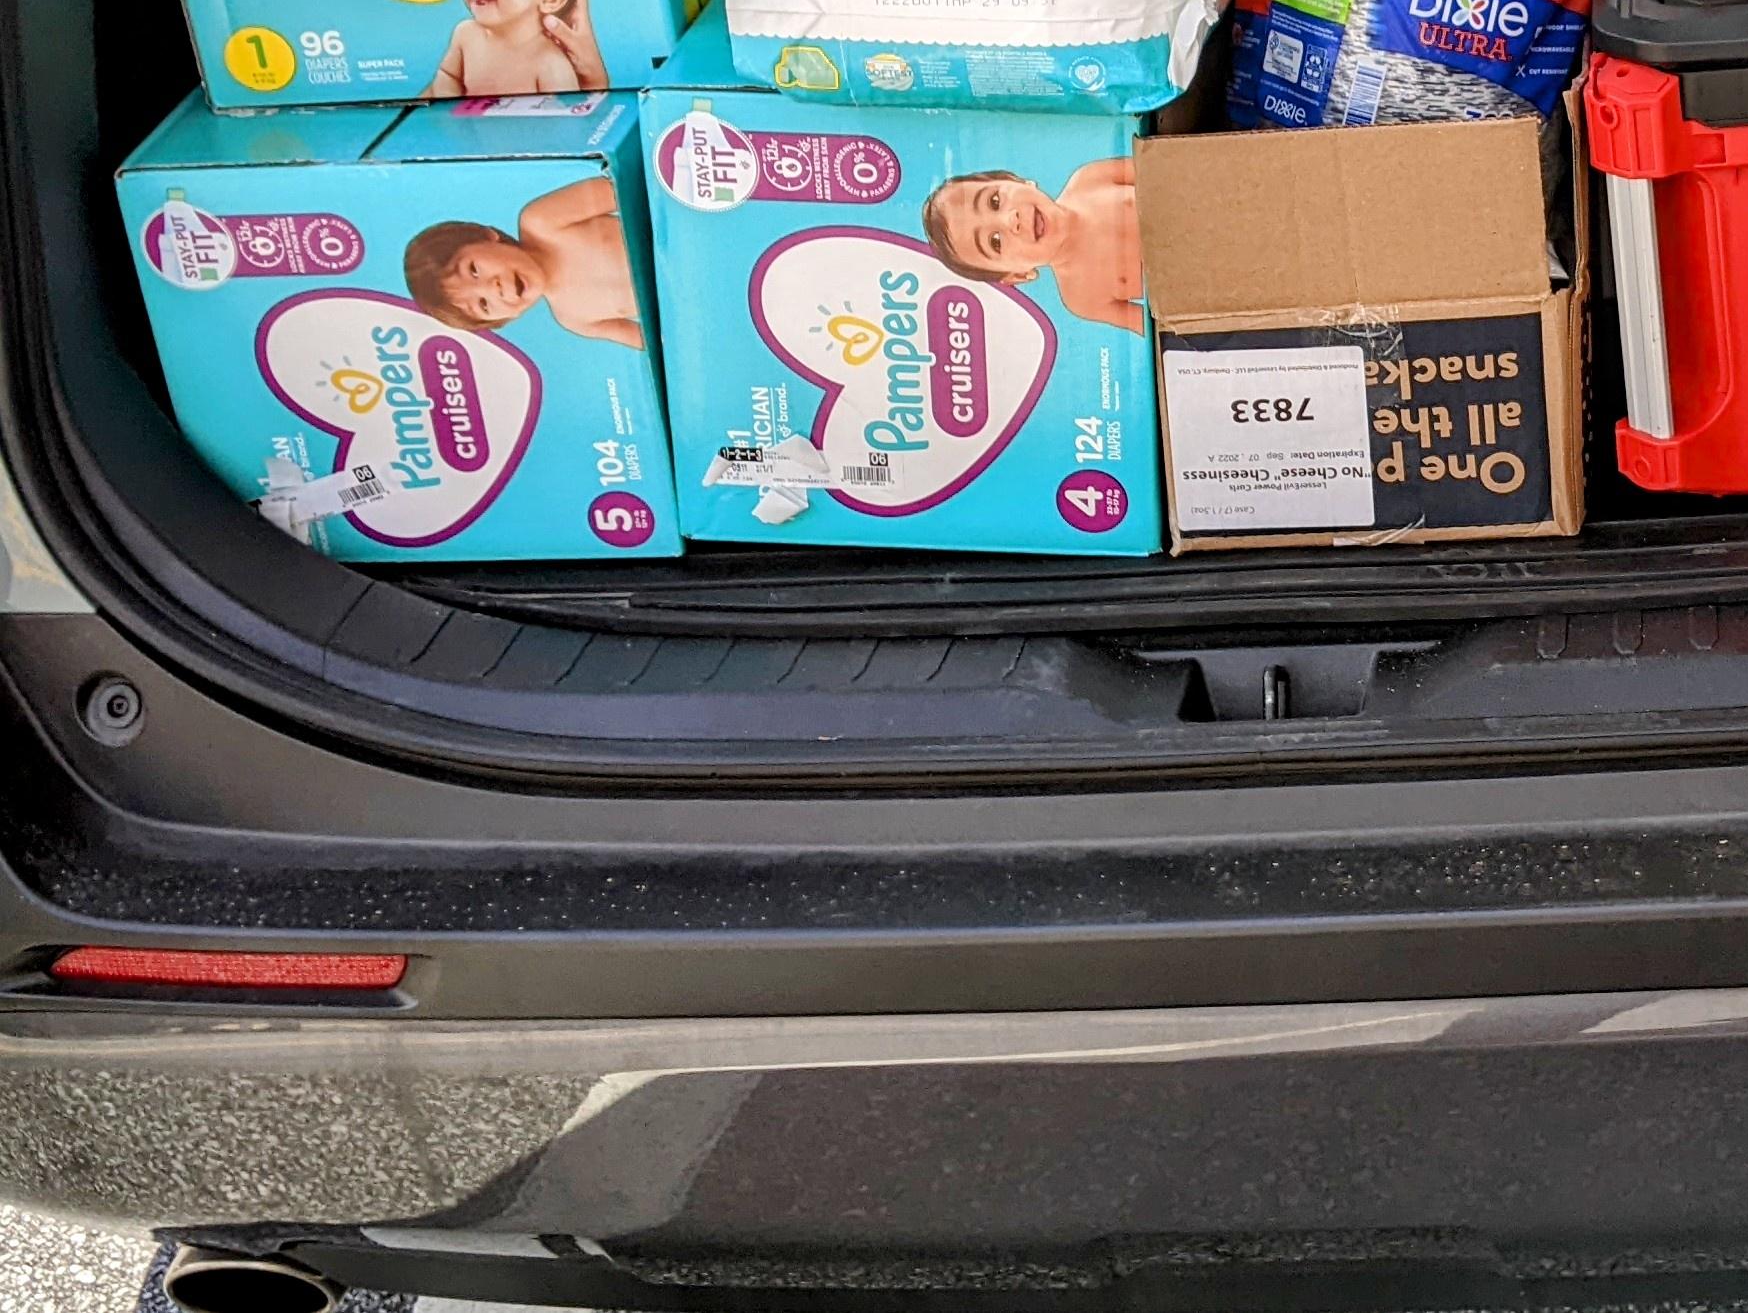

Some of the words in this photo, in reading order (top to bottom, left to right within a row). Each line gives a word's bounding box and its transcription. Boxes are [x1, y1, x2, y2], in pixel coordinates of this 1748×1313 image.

[246, 34, 268, 69] 1
[299, 30, 345, 57] 96
[1418, 21, 1511, 61] ULTRA
[304, 57, 349, 71] DIAPERS
[692, 127, 713, 198] STAY-PUT
[711, 146, 738, 184] FIT
[821, 156, 830, 178] FROM
[833, 140, 861, 197] HYPOALLERGENIC
[853, 151, 878, 184] 0%
[812, 173, 823, 199] LOCKS
[170, 215, 198, 279] STAY-PUT
[191, 231, 219, 265] FIT
[863, 270, 932, 452] Pampers
[944, 302, 974, 423] cruisers
[1101, 347, 1110, 367] PACK
[1101, 367, 1111, 410] ENORMOUS
[1364, 352, 1519, 400] snacka
[372, 326, 442, 490] Pampers
[436, 350, 477, 460] cruisers
[752, 386, 773, 450] RICIAN
[1230, 397, 1315, 424] 7833
[1372, 406, 1453, 449] the
[1467, 400, 1522, 446] all
[727, 430, 751, 448] #1
[1074, 417, 1104, 463] 124
[1106, 421, 1122, 460] DIAPERS
[1317, 450, 1366, 459] Expiration
[593, 439, 626, 487] 104
[624, 443, 642, 480] DIAPERS
[869, 453, 887, 466] 06
[1207, 454, 1214, 463] A
[1218, 453, 1240, 462] 2022
[1249, 453, 1260, 462] 07
[1266, 451, 1284, 461] Sep
[1290, 450, 1315, 460] Date:
[1376, 440, 1406, 483] p
[354, 466, 373, 482] 06
[1182, 468, 1270, 482] Cheesiness
[1229, 482, 1250, 492] Curls
[1254, 482, 1282, 491] Power
[1274, 467, 1338, 481] Cheese"
[1284, 481, 1328, 490] LesserEvil
[1341, 466, 1371, 479] "No
[1420, 451, 1526, 495] One
[1064, 486, 1104, 517] 4
[1234, 506, 1255, 514] Case
[593, 507, 633, 532] 5
